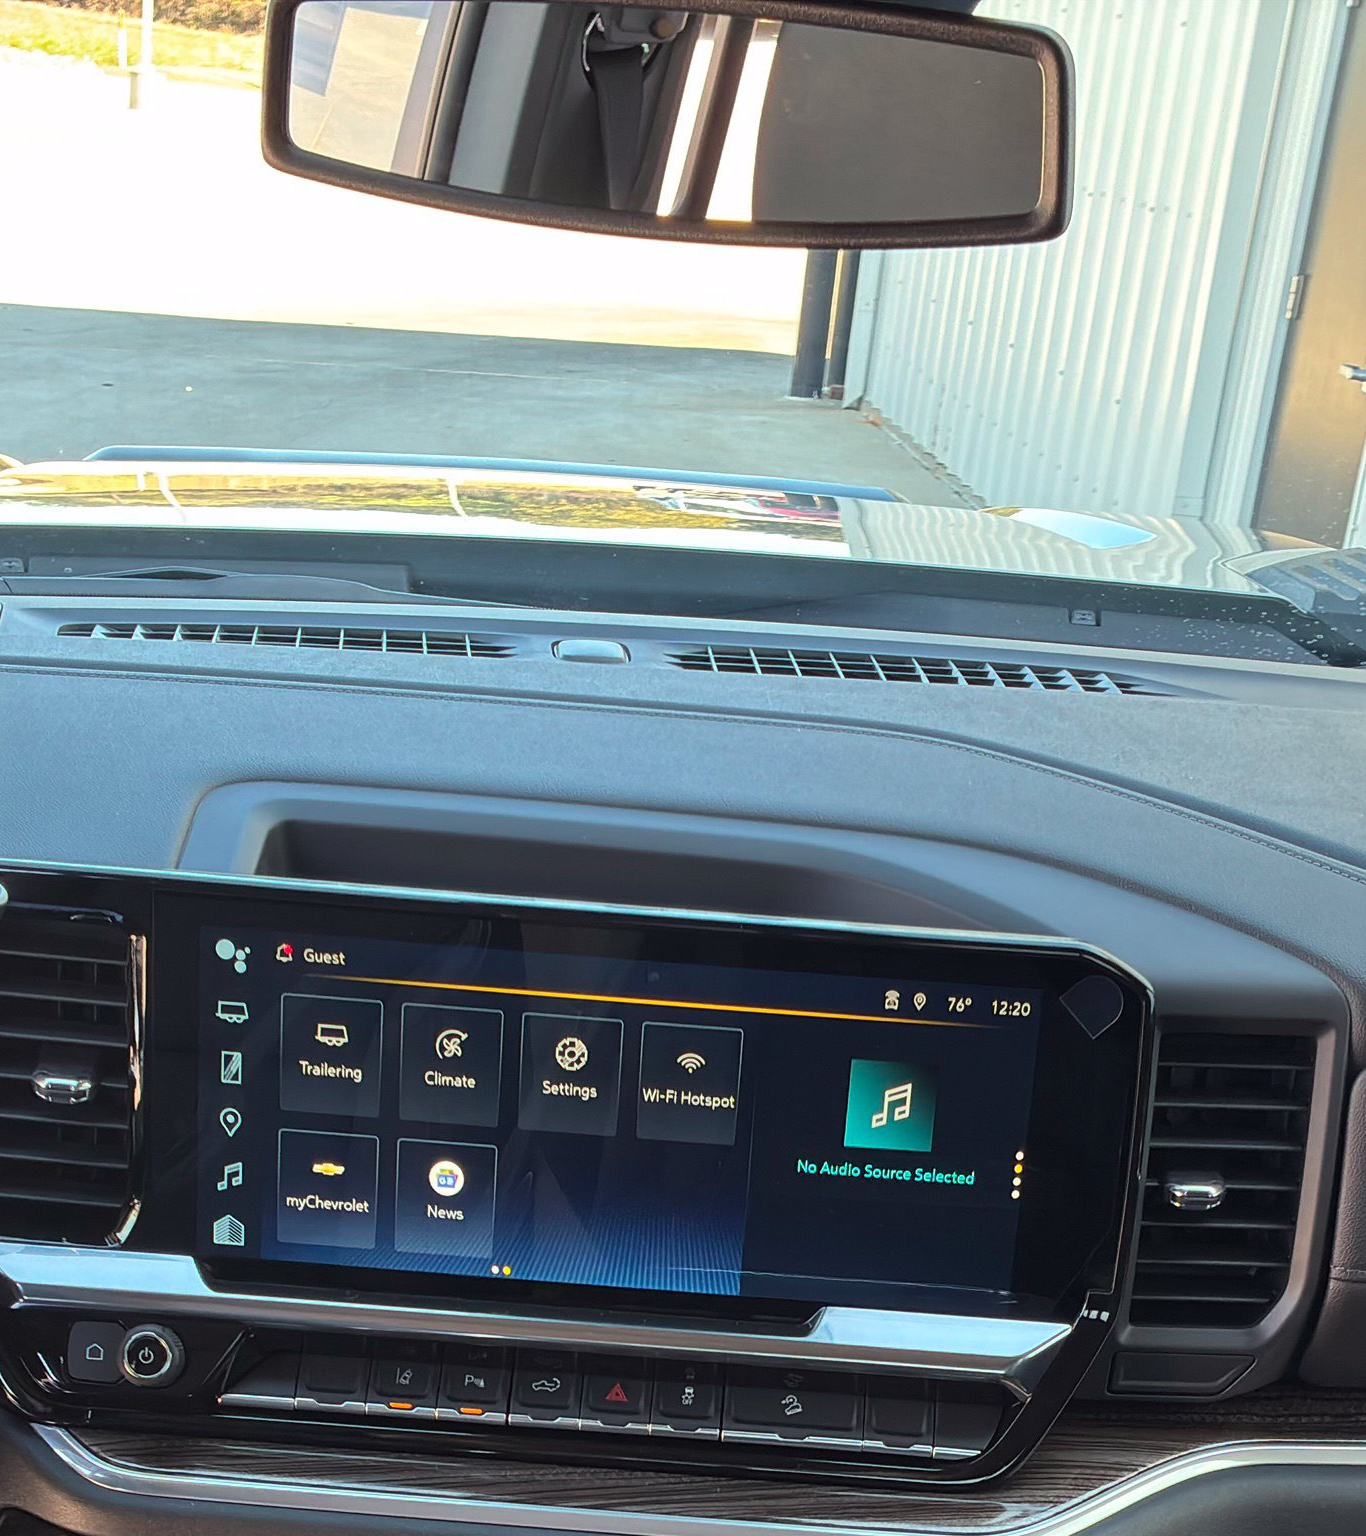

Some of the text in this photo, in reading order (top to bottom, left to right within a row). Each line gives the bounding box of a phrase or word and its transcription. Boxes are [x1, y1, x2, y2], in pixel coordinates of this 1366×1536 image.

[303, 948, 346, 966] Guest
[991, 1000, 1031, 1017] 12:20
[298, 1060, 363, 1084] Trailering
[424, 1070, 476, 1089] Climate
[542, 1079, 598, 1101] Settings
[642, 1086, 736, 1111] Wi-Fi Hotspot
[796, 1158, 976, 1186] No Audio Source Selected
[285, 1194, 370, 1214] myChevrolet
[426, 1204, 465, 1221] News
